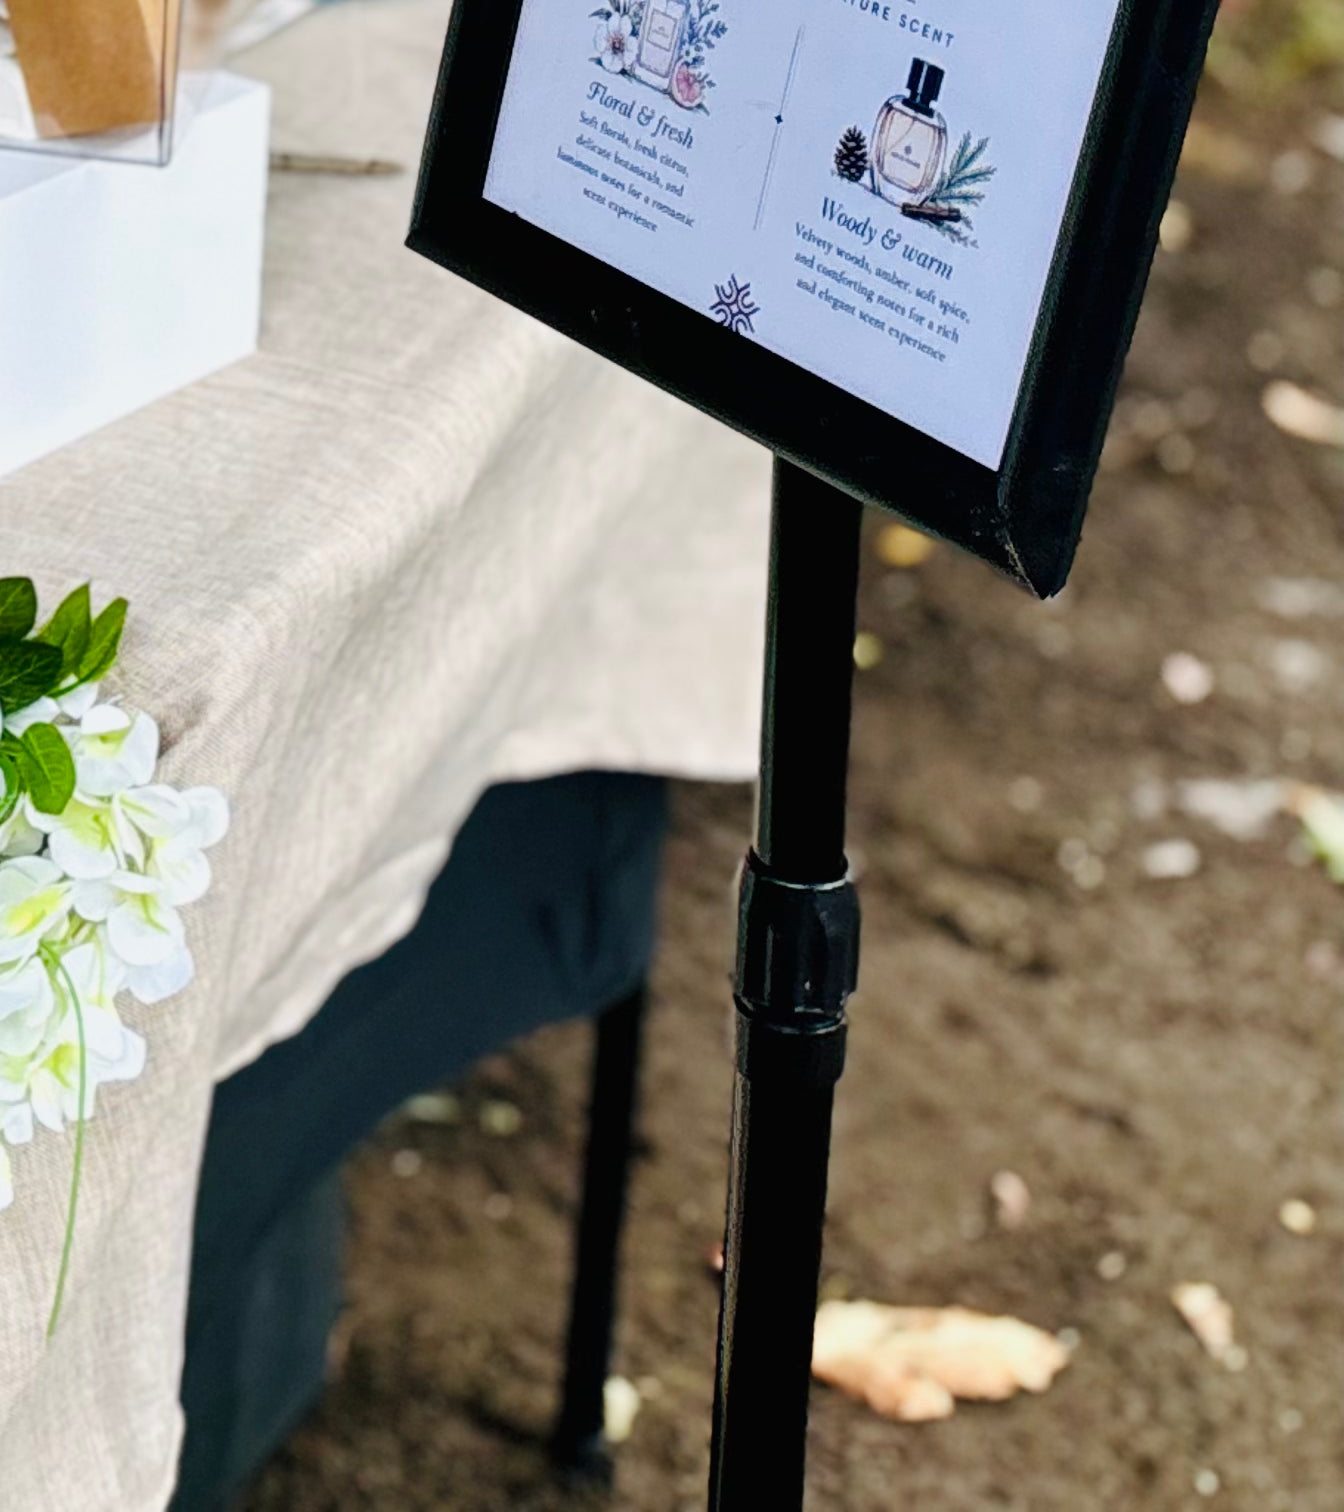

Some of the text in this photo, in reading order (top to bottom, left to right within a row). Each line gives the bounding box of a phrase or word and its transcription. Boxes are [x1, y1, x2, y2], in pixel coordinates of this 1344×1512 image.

[899, 14, 954, 48] SCENT
[579, 111, 598, 129] Soft
[634, 139, 657, 160] fresh
[587, 81, 693, 149] Floral & fresh
[601, 172, 625, 191] notes
[628, 184, 641, 199] for
[666, 183, 684, 197] and
[608, 201, 657, 232] experience
[821, 197, 953, 280] Woody & warm
[795, 222, 970, 324] Velvety woods, amber, soft spice,
[795, 252, 959, 343] and comforting notes for a rich
[796, 278, 946, 362] and elegant scent experience
